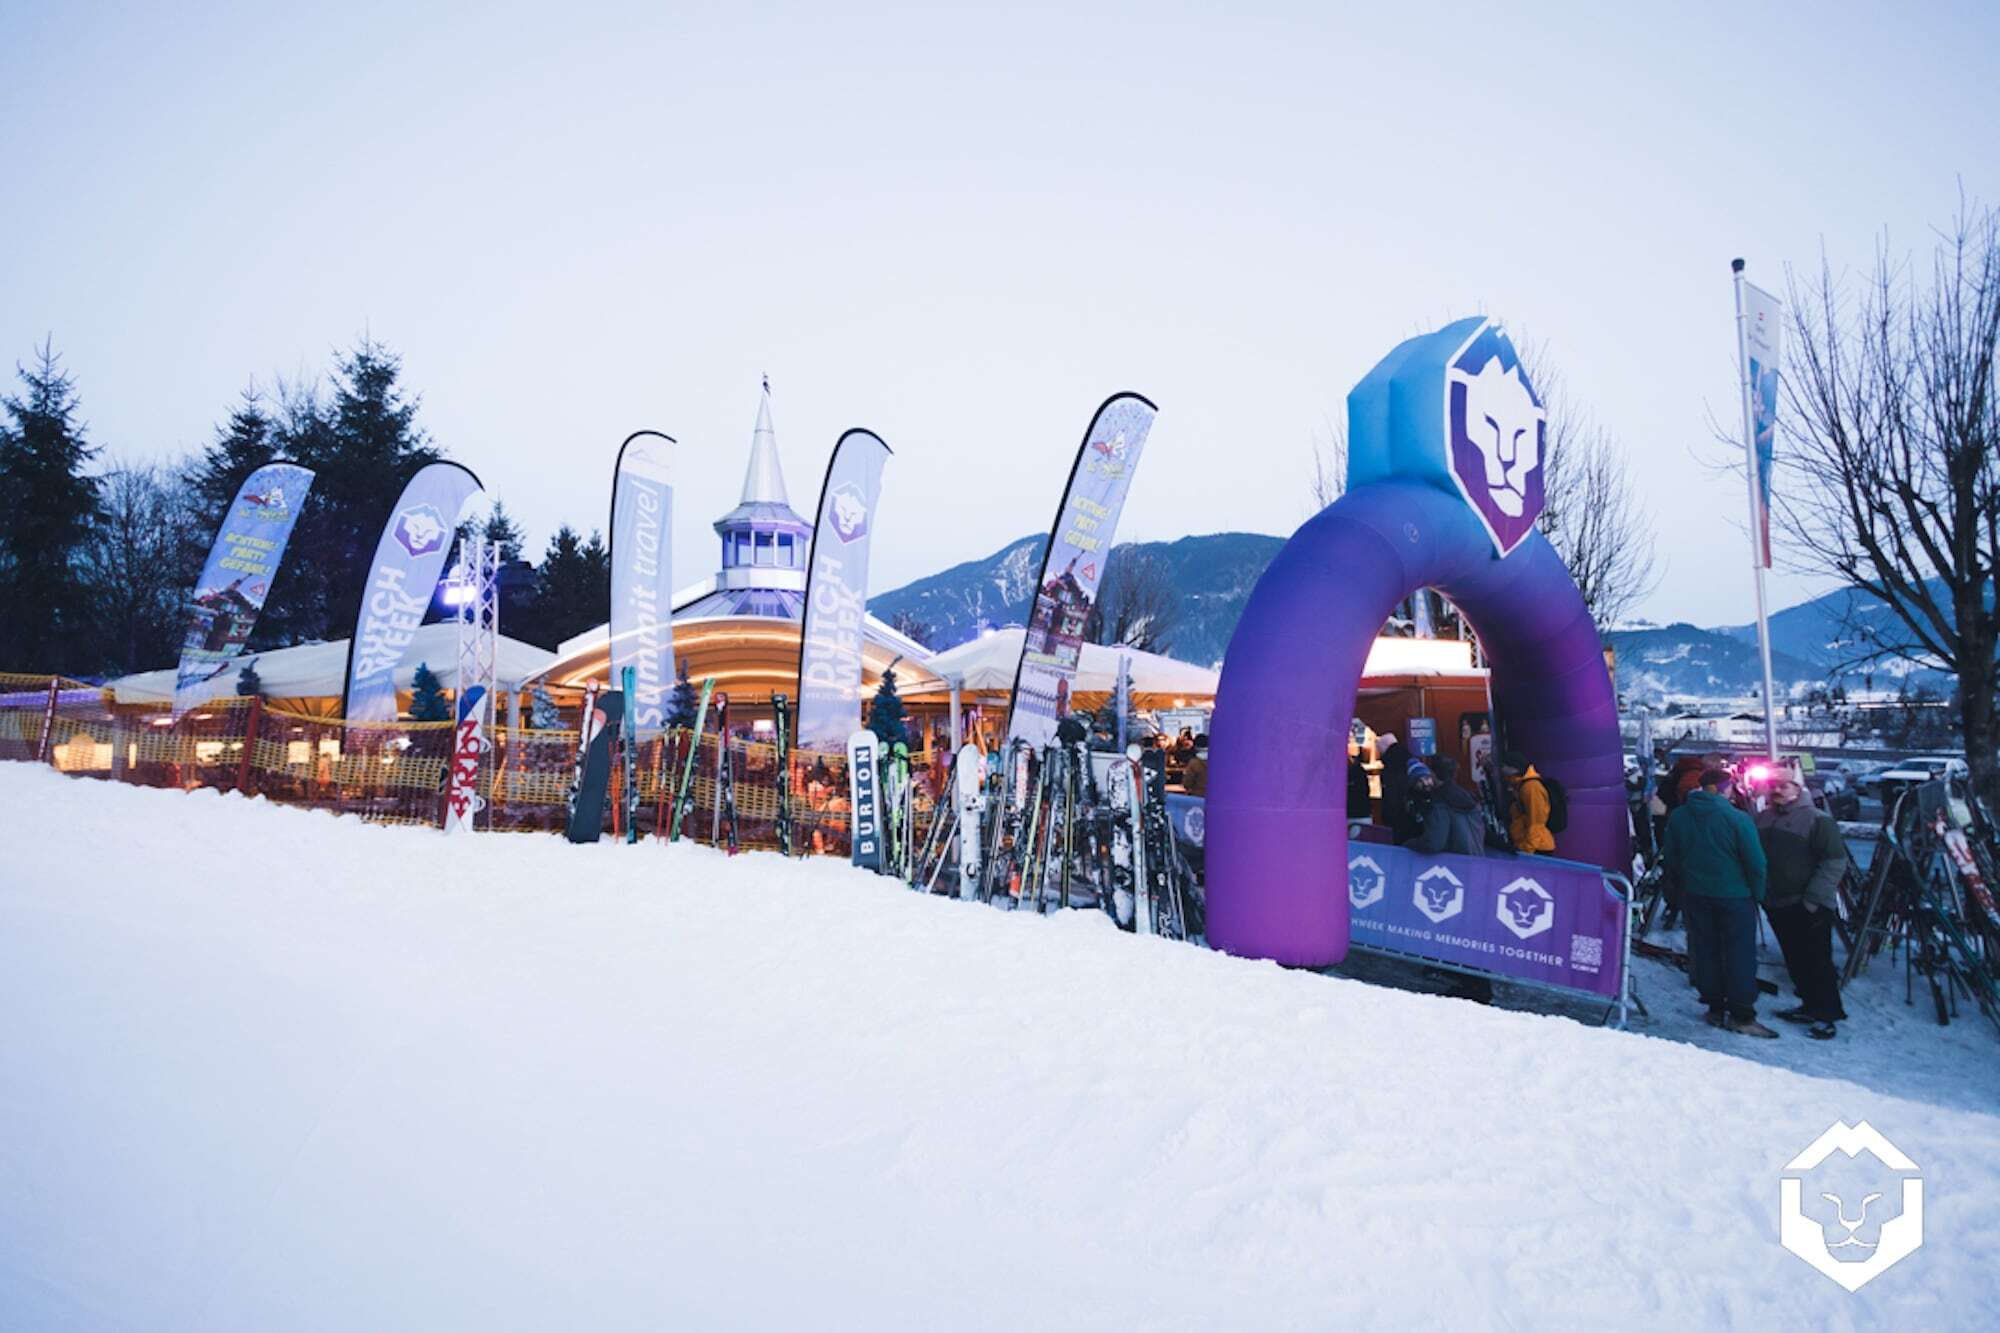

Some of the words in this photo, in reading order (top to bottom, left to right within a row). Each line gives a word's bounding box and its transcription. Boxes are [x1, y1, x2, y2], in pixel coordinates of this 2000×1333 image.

[632, 479, 658, 576] travel
[355, 565, 406, 680] DUTCH
[372, 589, 428, 674] WEEK
[807, 555, 842, 685] DUTCH
[836, 583, 864, 687] WEEK
[857, 749, 875, 854] BURTON
[1351, 918, 1385, 931] HWEEK
[1387, 923, 1432, 941] MAKING
[1435, 933, 1496, 954] MEMORIES
[1499, 945, 1564, 967] TOGETHER
